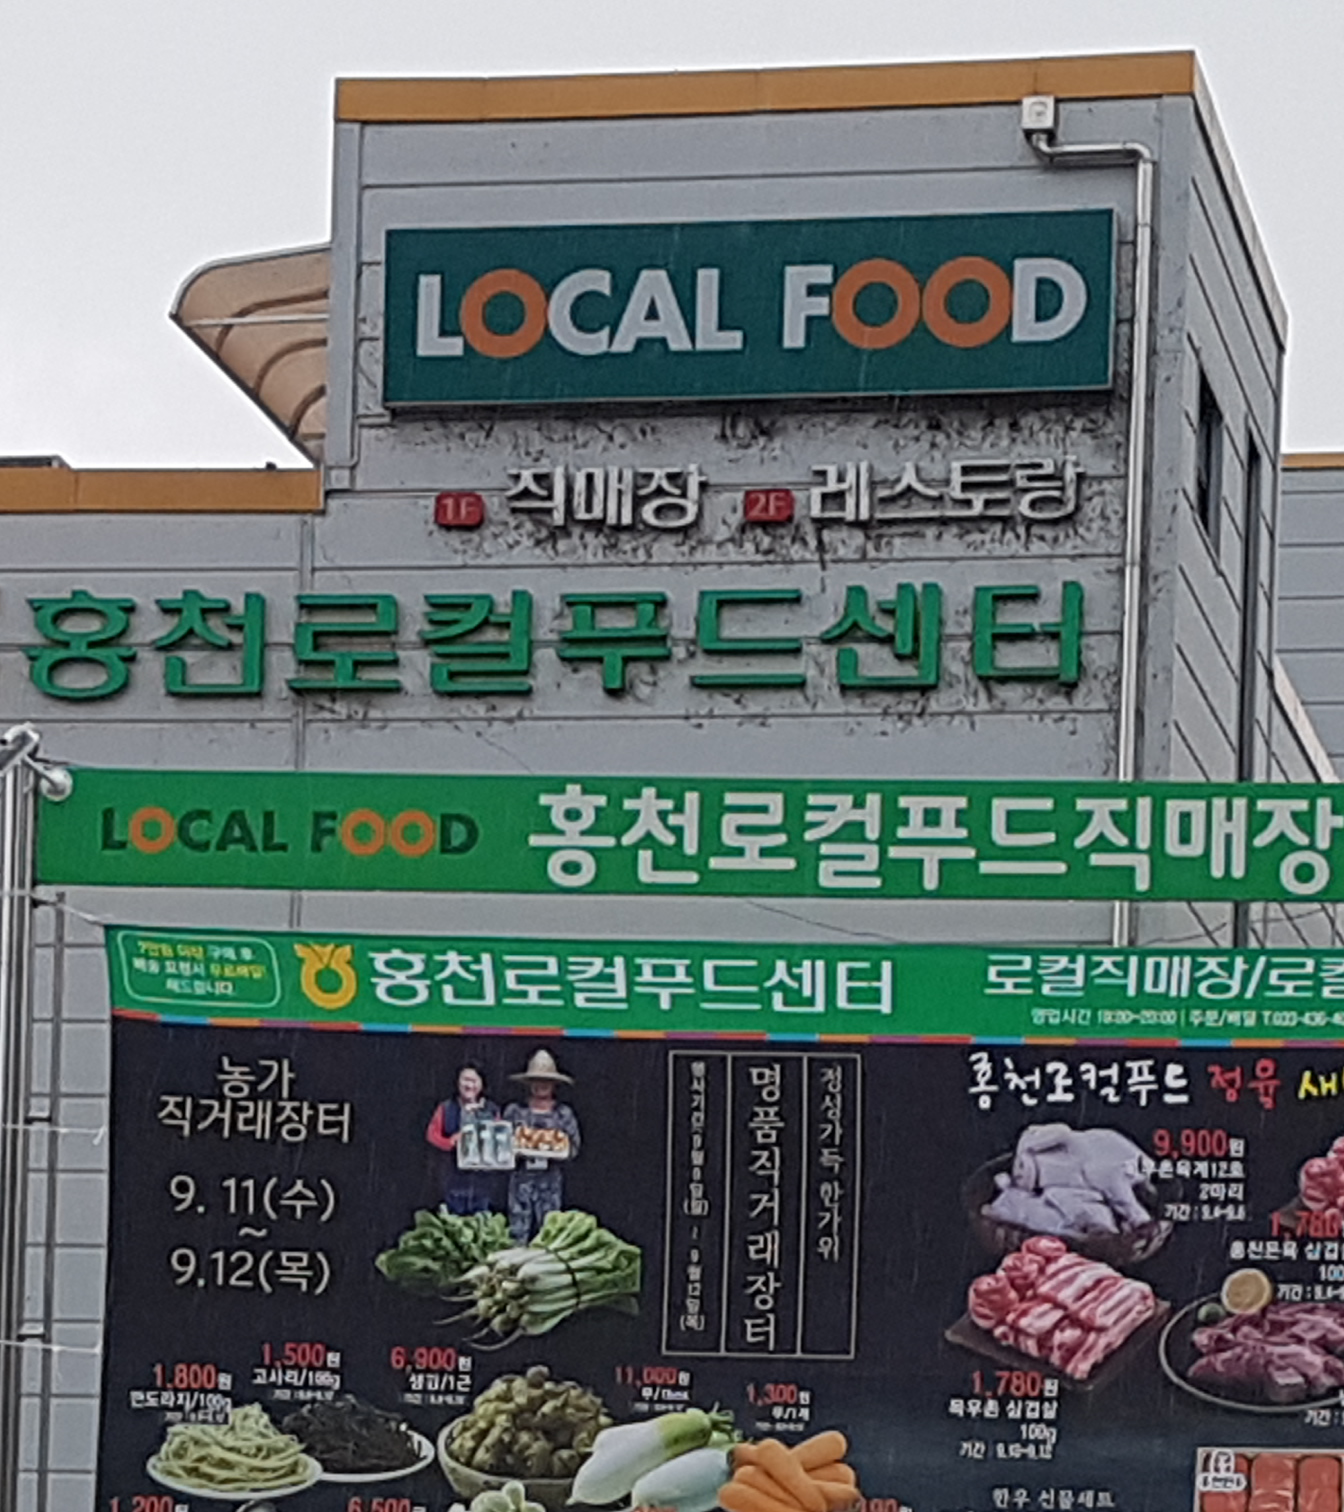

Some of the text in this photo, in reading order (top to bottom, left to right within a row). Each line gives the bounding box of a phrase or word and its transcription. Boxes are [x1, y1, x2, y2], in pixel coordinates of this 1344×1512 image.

[415, 257, 1088, 360] LOCAL FOOD
[440, 462, 709, 529] 1F 직매장
[748, 453, 1082, 524] 2F 레스토랑
[26, 581, 1084, 700] 홍천로컬푸드센터
[101, 806, 480, 856] LOCAL FOOD
[369, 947, 895, 1016] 홍천로컬푸드센터
[1031, 1008, 1091, 1026] 영업시간
[216, 1055, 296, 1099] 농가
[968, 1052, 1189, 1109] 홍천로컬푸드
[1207, 1057, 1282, 1110] 정육
[158, 1095, 351, 1144] 직거래장터
[817, 1064, 845, 1263] 정성가득 한가위
[1153, 1128, 1245, 1159] 9,900원
[744, 1063, 785, 1352] 명품직거래장터
[170, 1248, 331, 1295] 9.12(목)
[153, 1363, 232, 1391] 1,800원
[261, 1342, 341, 1369] 1,500원
[390, 1346, 472, 1373] 6,900원
[972, 1370, 1058, 1399] 1,780원
[1006, 1399, 1058, 1419] 삼겹살
[1020, 1423, 1057, 1445] 100g
[992, 1487, 1030, 1509] 한우
